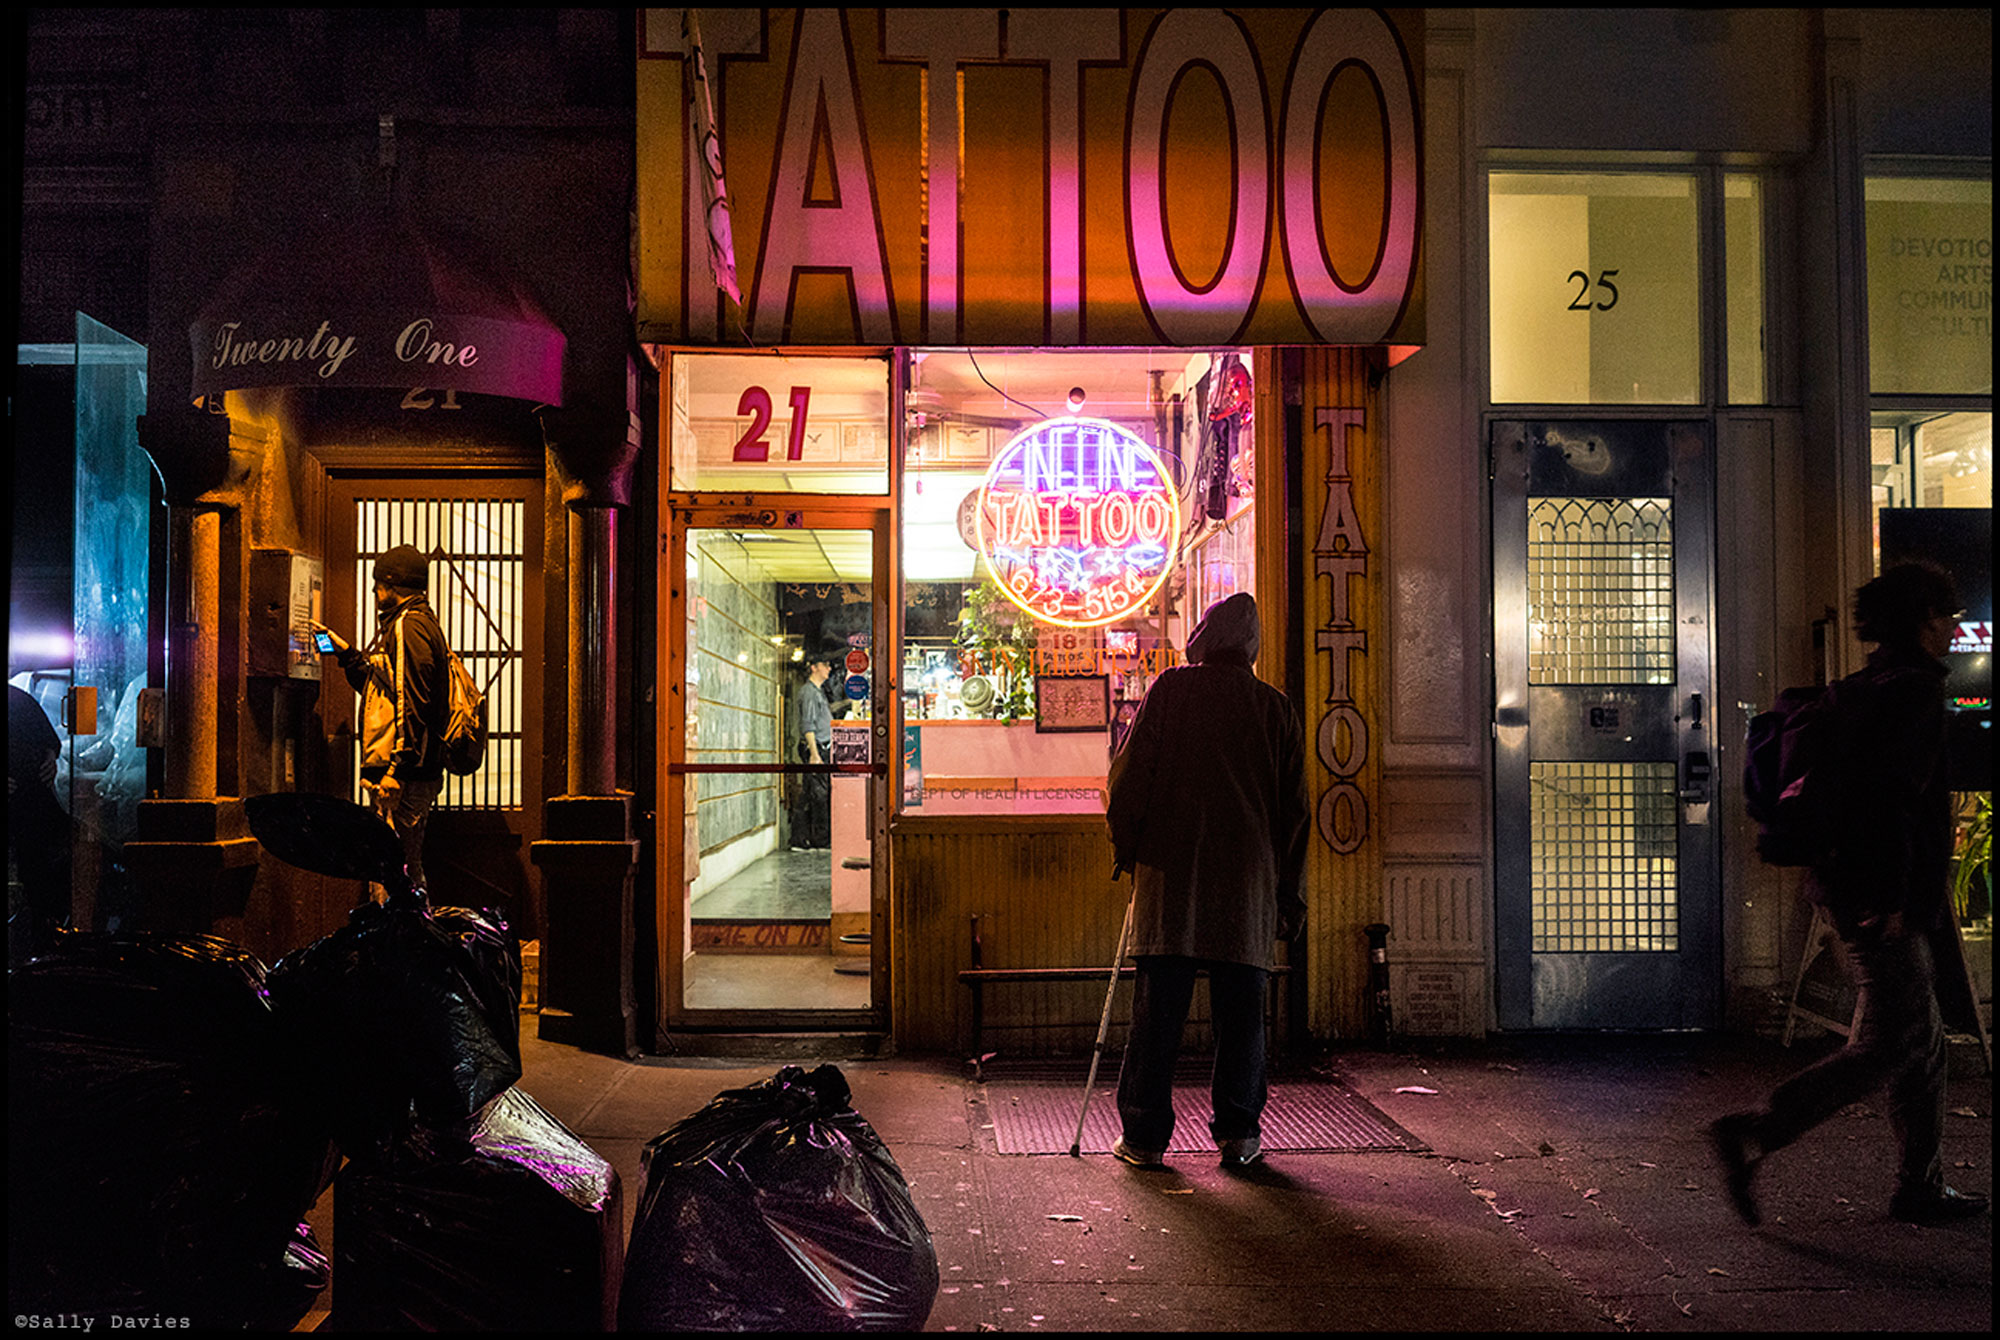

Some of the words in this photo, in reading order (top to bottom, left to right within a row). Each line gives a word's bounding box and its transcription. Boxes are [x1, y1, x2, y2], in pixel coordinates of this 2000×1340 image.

[638, 8, 1423, 346] TATTOO
[1567, 269, 1619, 311] 25
[212, 320, 357, 378] Twenty
[395, 318, 478, 368] One
[732, 386, 811, 462] 21
[987, 492, 1170, 547] TATTOO
[1009, 566, 1147, 618] 673-5154
[1053, 634, 1078, 650] 18
[1313, 407, 1370, 855] TATTOO
[953, 648, 1016, 678] SKIN
[951, 788, 971, 800] OF
[975, 788, 1031, 800] HEALTH
[1034, 787, 1101, 799] LICENSED
[754, 925, 789, 946] ON
[799, 925, 825, 946] IN
